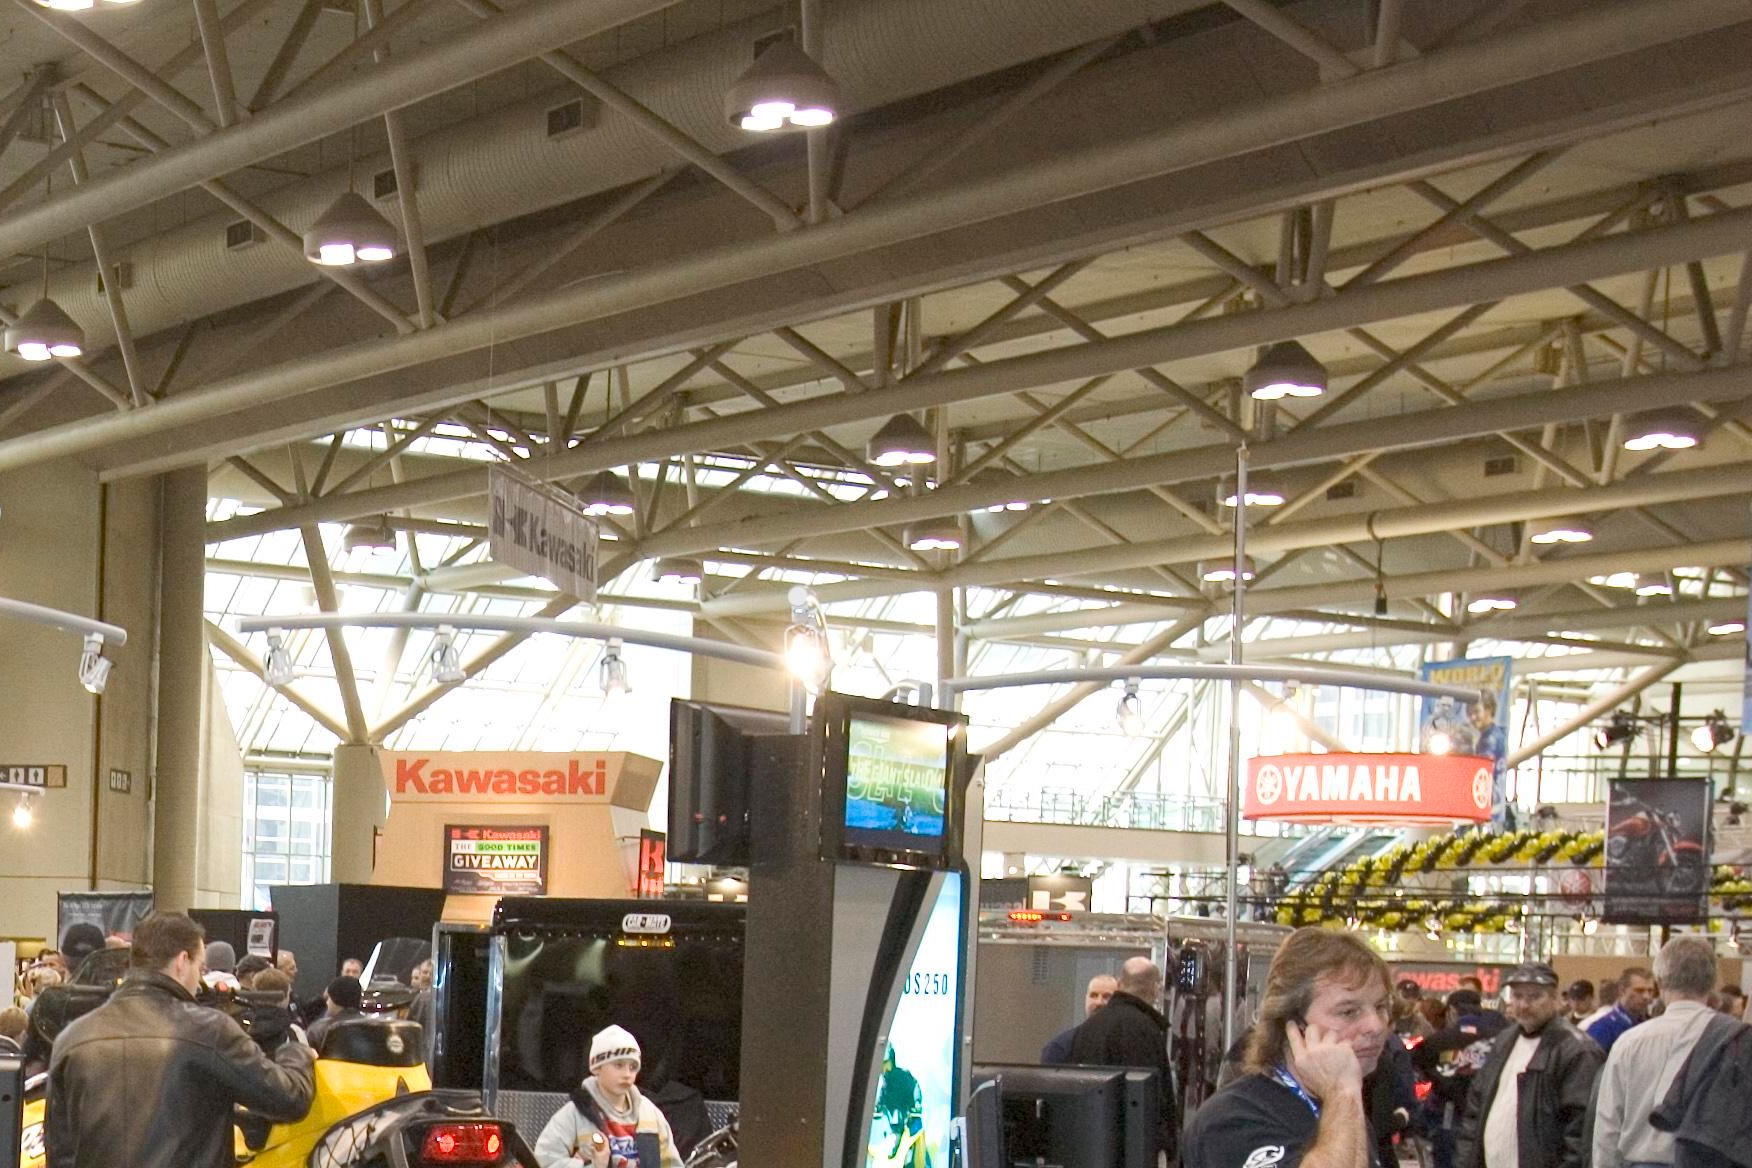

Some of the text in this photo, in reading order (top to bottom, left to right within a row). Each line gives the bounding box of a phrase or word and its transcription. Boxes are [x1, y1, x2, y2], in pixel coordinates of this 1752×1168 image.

[395, 758, 607, 796] Kawasaki
[1282, 764, 1422, 802] YAMAHA
[482, 829, 541, 840] Kawasaki
[455, 843, 536, 851] THE GOOD TIMES
[454, 854, 537, 869] GIVEAWAY
